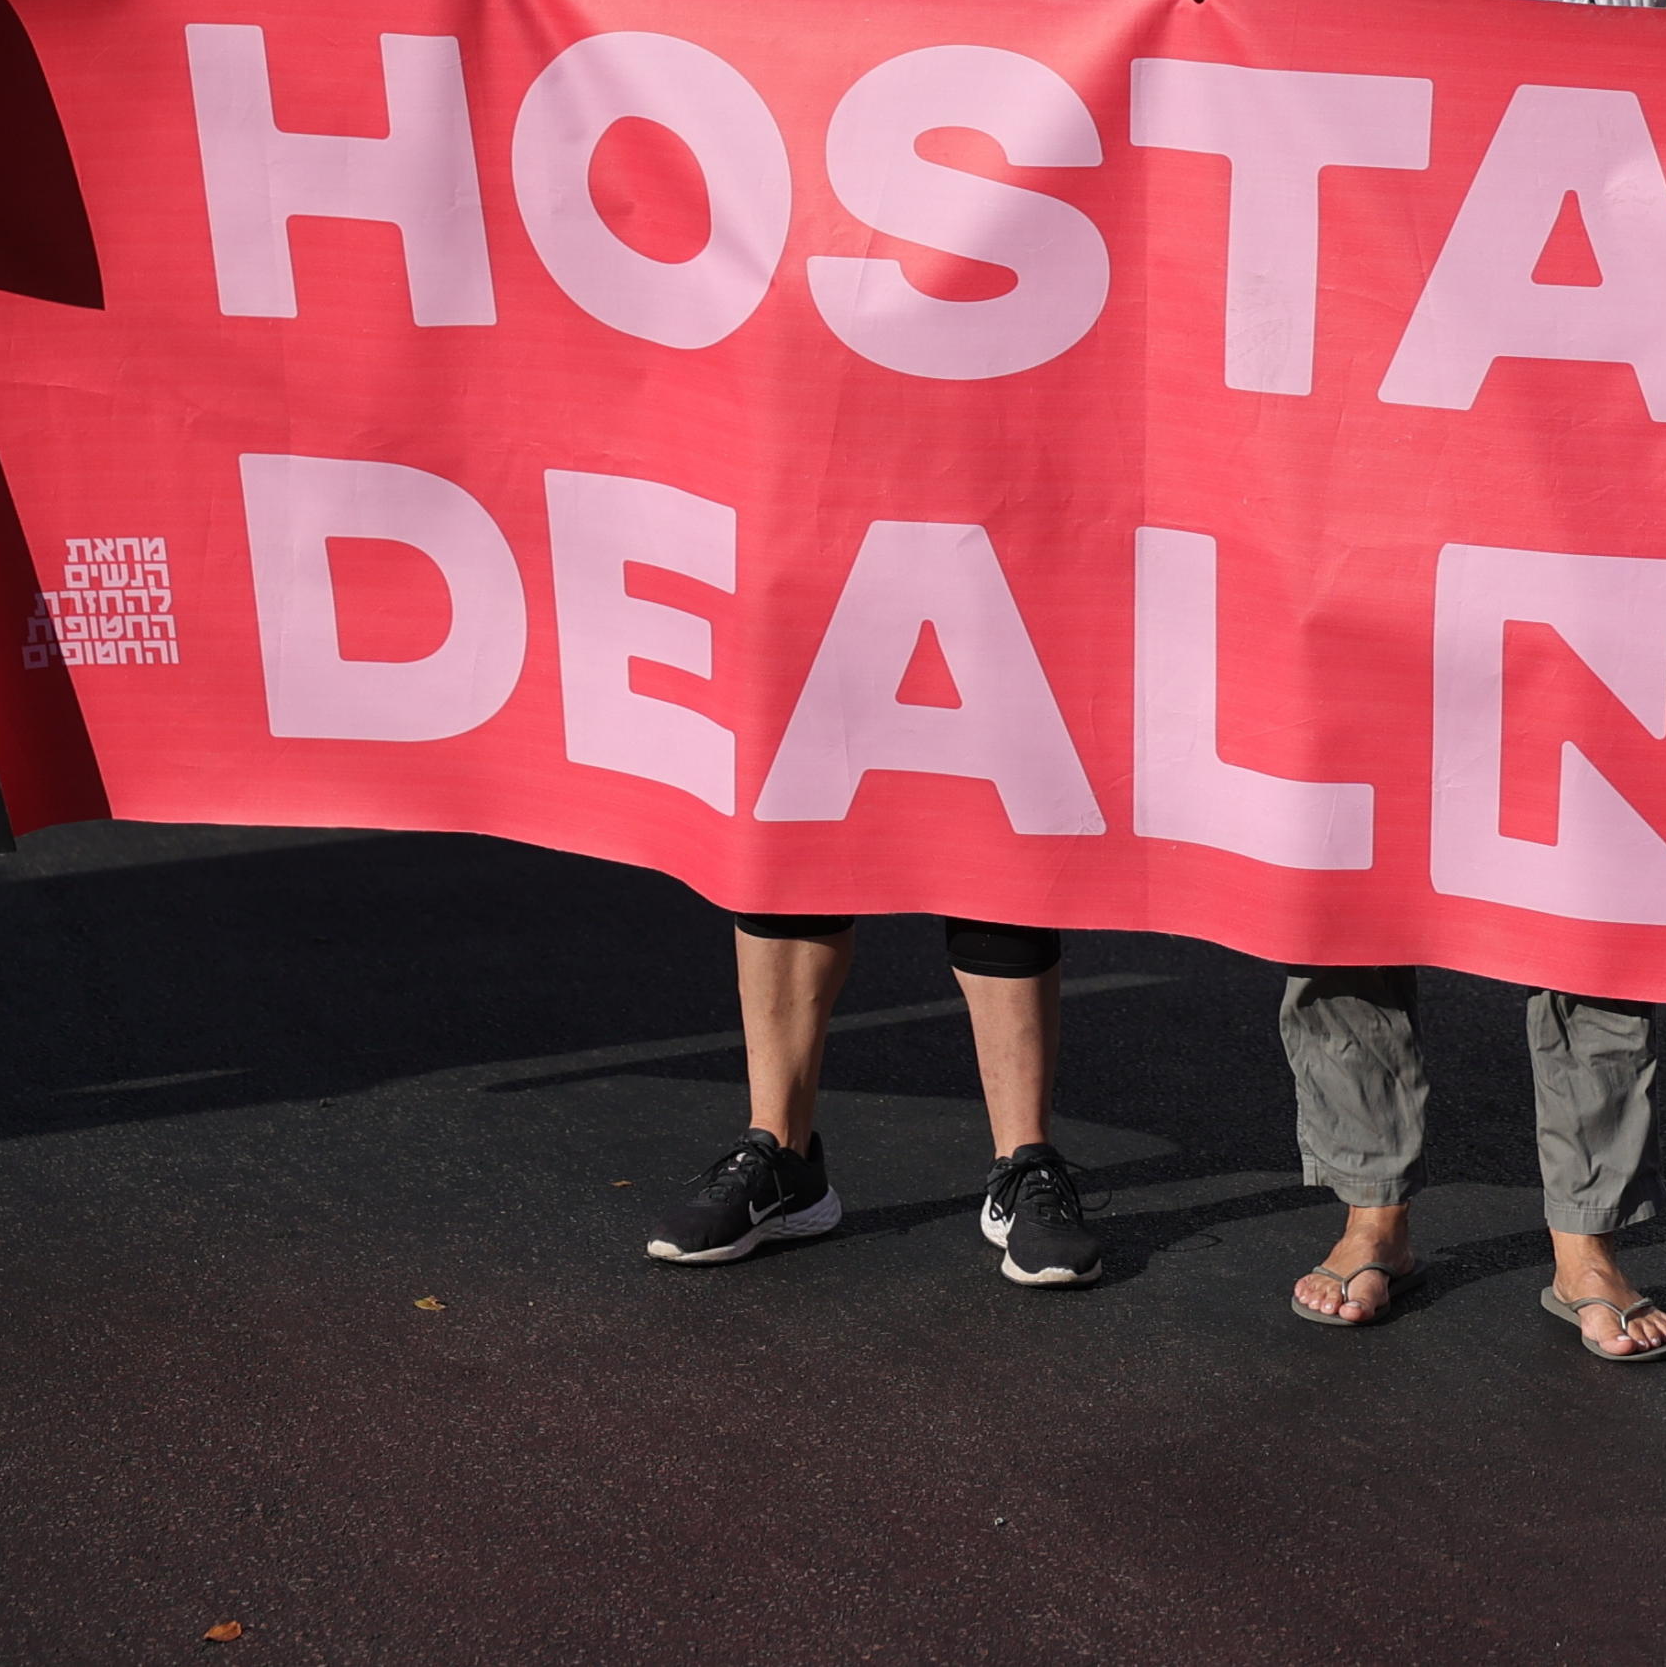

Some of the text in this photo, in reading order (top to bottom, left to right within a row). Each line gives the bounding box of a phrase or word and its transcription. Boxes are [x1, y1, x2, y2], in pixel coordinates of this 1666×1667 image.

[64, 536, 167, 563] מחאת
[63, 563, 170, 589] הנשים
[35, 584, 173, 616] להחזרת
[27, 614, 177, 643] החטופות
[22, 640, 181, 670] והחטופים
[236, 454, 1374, 873] DEAL
